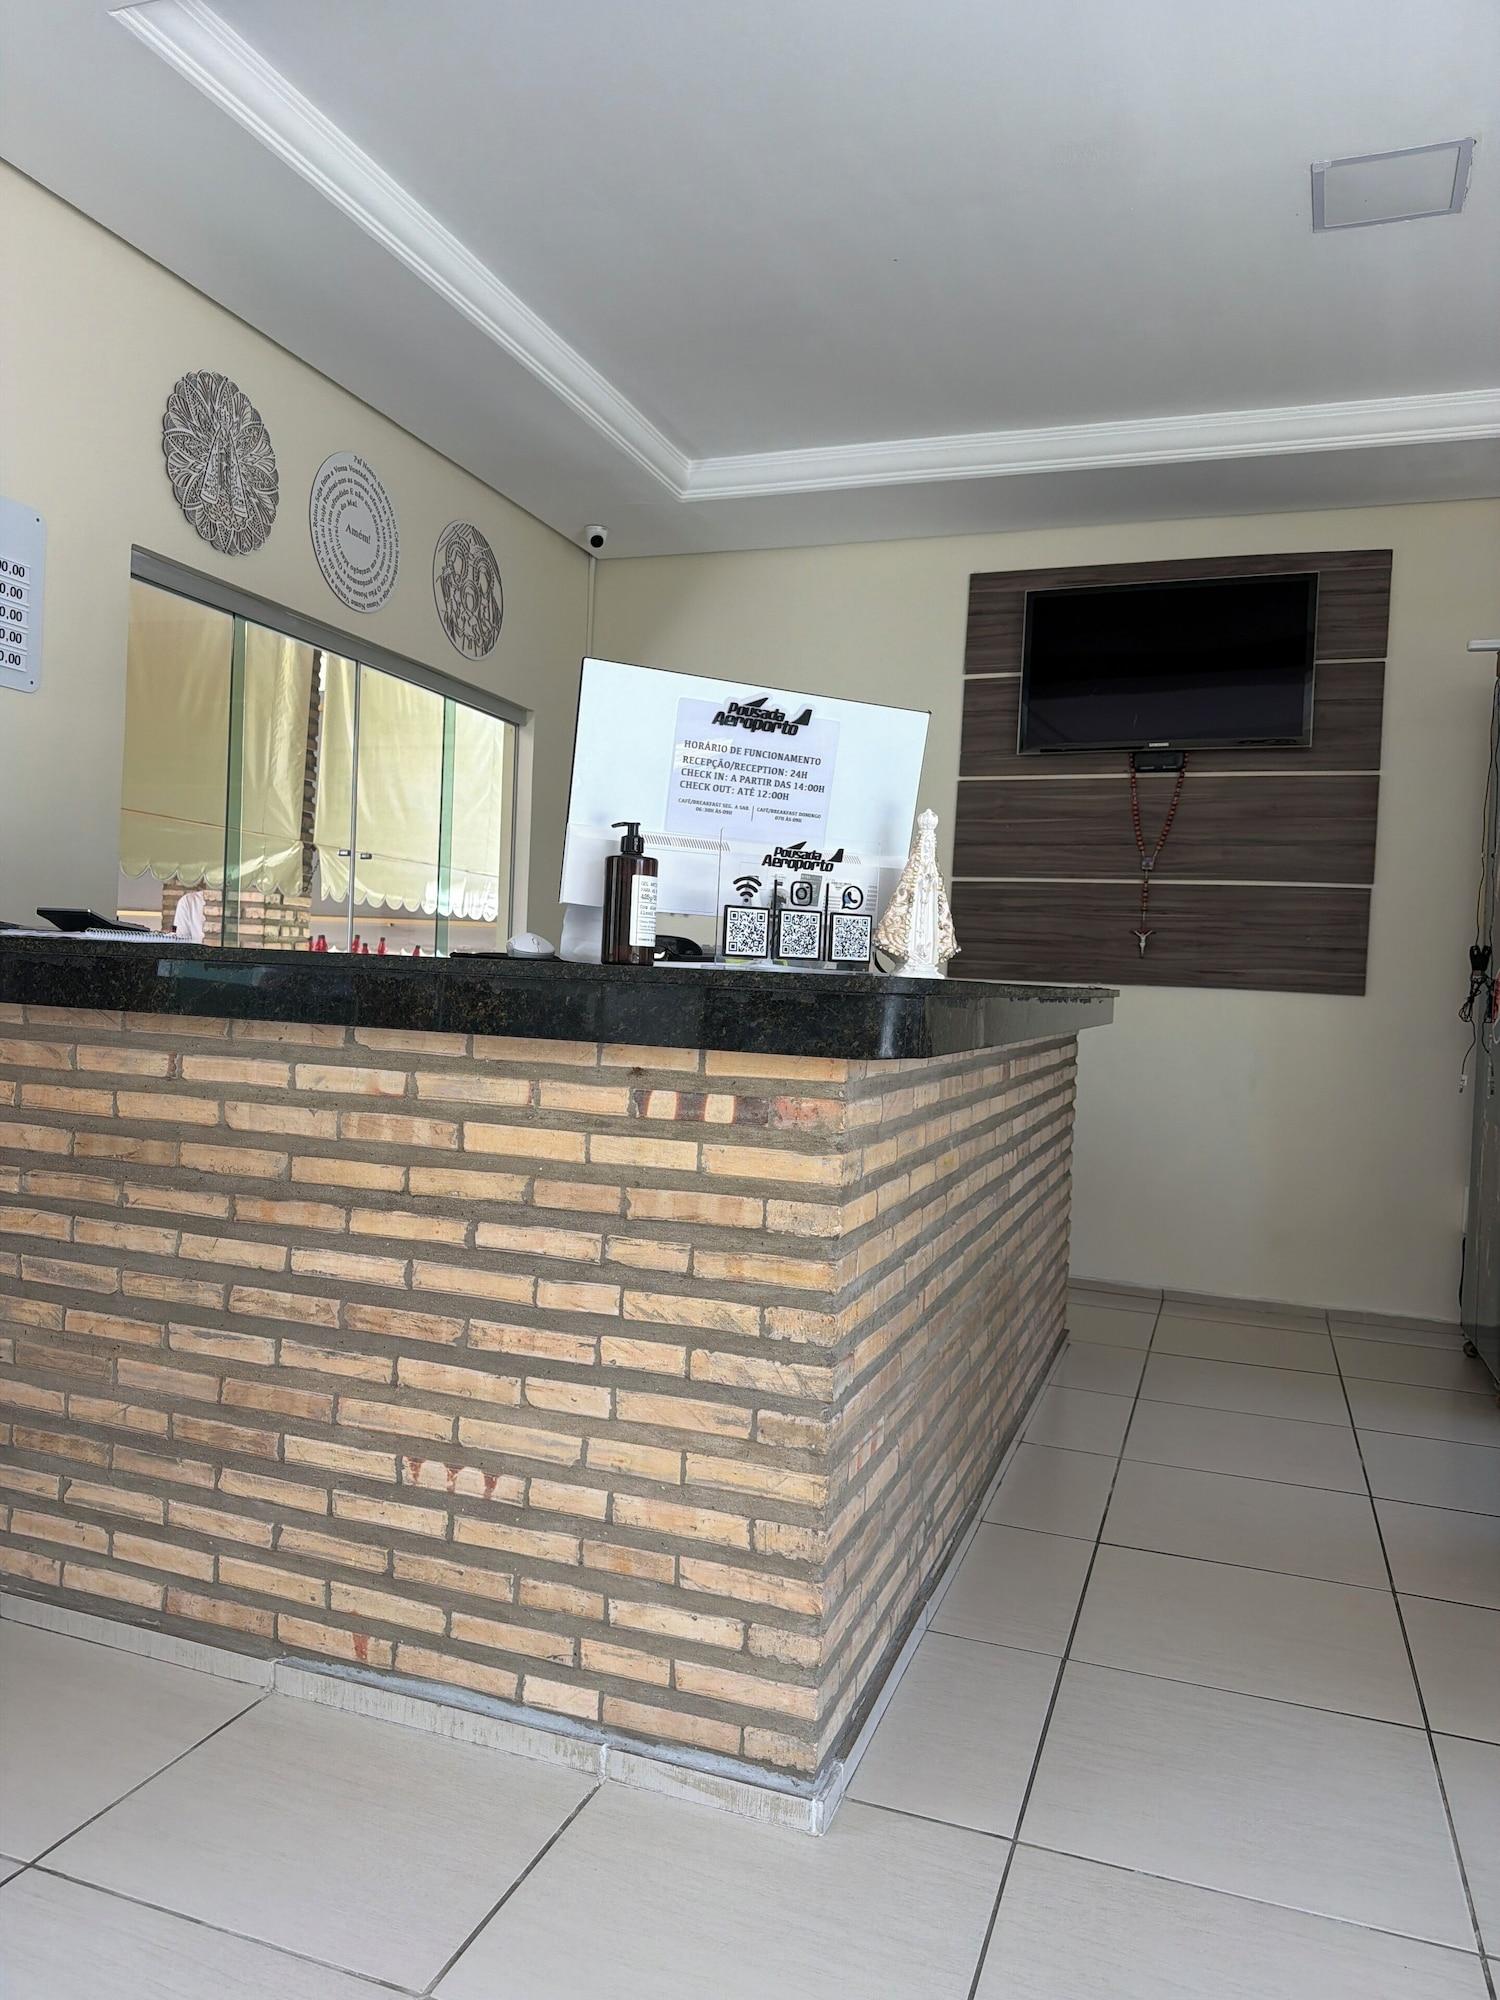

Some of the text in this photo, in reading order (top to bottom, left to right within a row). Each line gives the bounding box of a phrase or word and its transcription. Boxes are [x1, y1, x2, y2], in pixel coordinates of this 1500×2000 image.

[346, 523, 370, 544] Amém!
[0, 560, 25, 577] 0,00
[728, 702, 786, 722] Pousada
[712, 712, 799, 736] Aeroporto
[684, 739, 821, 766] HORÁRIO DE FUNCIONAMENTO
[682, 755, 808, 779] RECEPÇÃO/RECEPTION: 24H
[680, 780, 789, 801] CHECK OUT: ATÉ 12:00H
[681, 768, 712, 780] CHECK
[714, 772, 728, 781] IN:
[739, 775, 772, 787] PARTIR
[774, 780, 791, 789] DAS
[794, 782, 825, 793] 14:00H
[762, 854, 834, 872] Aeroporto
[774, 846, 822, 860] Pousada
